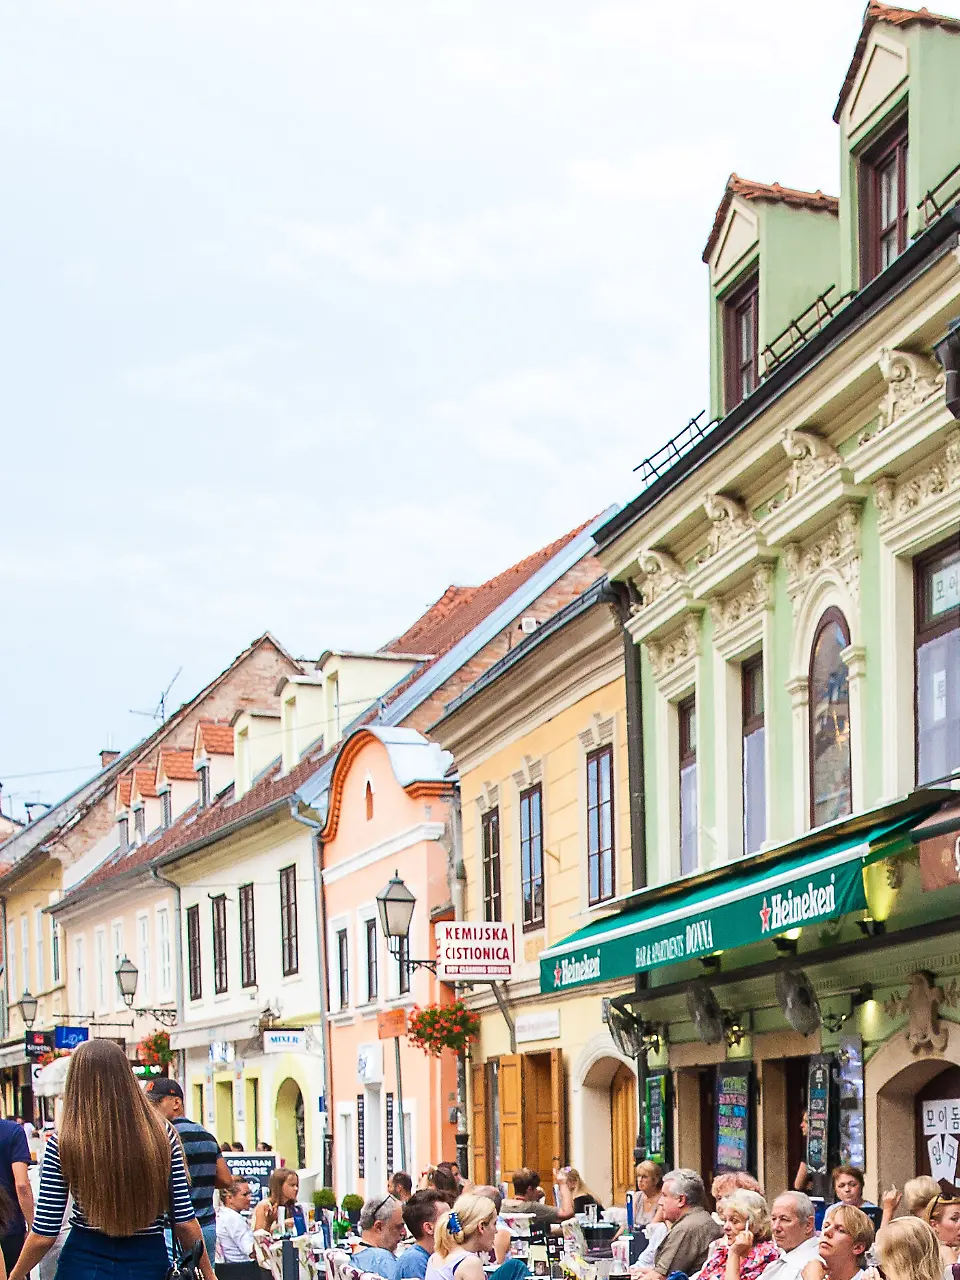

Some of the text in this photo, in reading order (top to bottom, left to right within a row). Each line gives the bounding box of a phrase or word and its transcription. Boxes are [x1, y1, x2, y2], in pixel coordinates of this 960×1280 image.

[771, 876, 836, 931] Heineken
[445, 927, 508, 941] KEMIJSKA
[561, 952, 601, 986] Heineken
[270, 1035, 299, 1044] MIXER
[227, 1159, 272, 1167] CROATIAN
[232, 1167, 268, 1175] STORE
